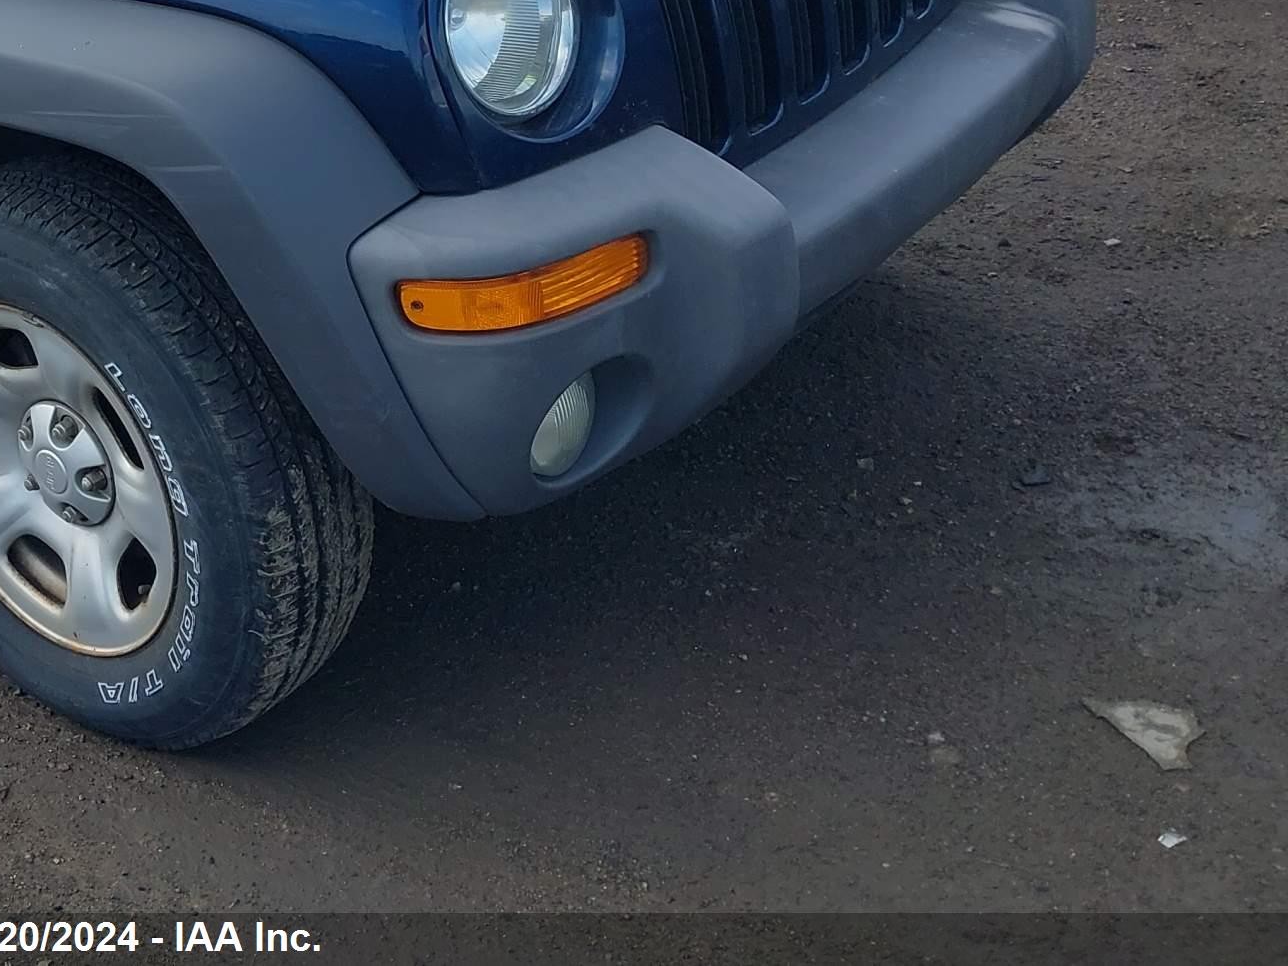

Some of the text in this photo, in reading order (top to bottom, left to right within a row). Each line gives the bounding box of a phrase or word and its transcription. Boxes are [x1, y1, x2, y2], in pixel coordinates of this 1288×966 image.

[98, 362, 201, 704] Long Trail T/A
